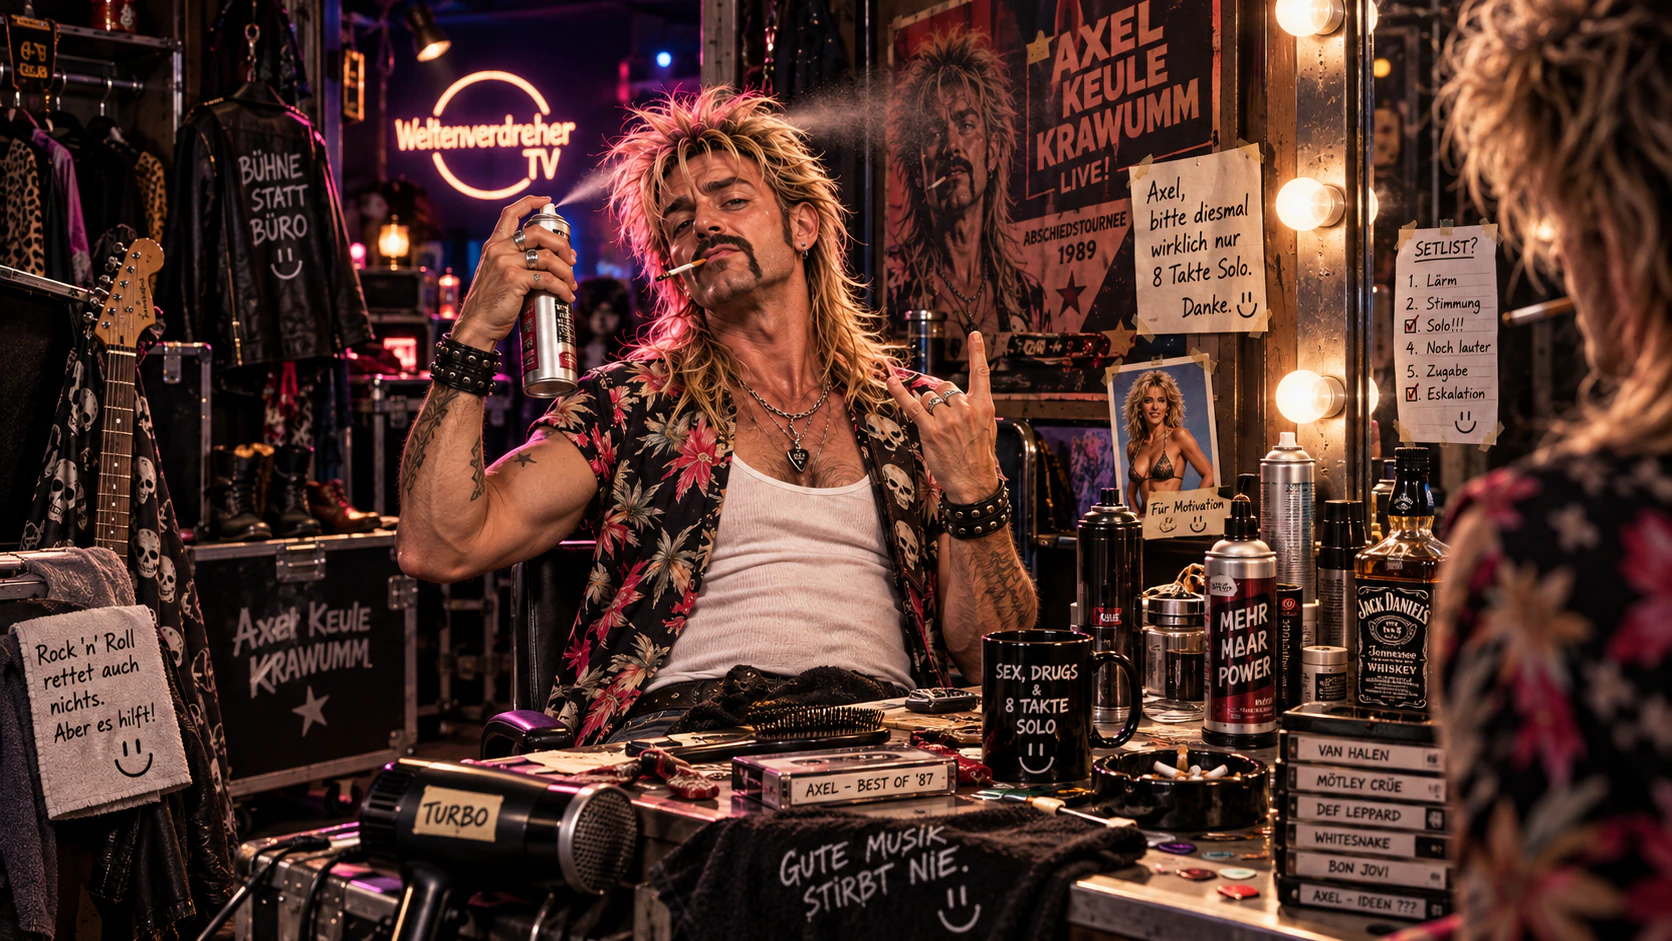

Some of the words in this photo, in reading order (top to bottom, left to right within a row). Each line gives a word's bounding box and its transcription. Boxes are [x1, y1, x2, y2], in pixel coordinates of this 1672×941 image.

[1050, 0, 1164, 85] AXEL
[1062, 43, 1169, 119] KEULE
[394, 113, 576, 151] Weltenverdreher
[1036, 77, 1200, 172] KRAWUMM
[238, 149, 303, 187] BÜHNE
[522, 147, 562, 180] TV
[1060, 156, 1110, 194] LIVE!
[251, 183, 309, 213] STATT
[1147, 176, 1185, 204] Axel,
[1150, 208, 1187, 231] bitte
[1194, 193, 1249, 223] diesmal
[249, 212, 308, 247] BÜRO
[1023, 211, 1127, 247] ABSCHIEDSTOURNEE
[1057, 240, 1097, 264] 1989
[1151, 231, 1207, 258] wirklich
[1215, 233, 1241, 249] nur
[1414, 237, 1478, 257] SETLIST?
[1152, 266, 1162, 287] 8
[1169, 261, 1211, 285] Takte
[1217, 255, 1252, 279] Solo.
[1408, 274, 1418, 288] 1.
[1427, 273, 1457, 287] Lärm
[1182, 294, 1232, 318] Danke.
[1406, 297, 1418, 311] 2.
[1427, 296, 1481, 314] Stimmung
[1427, 317, 1464, 332] Solo!!!
[1406, 341, 1418, 355] 4.
[1427, 341, 1454, 354] Noch
[1459, 339, 1491, 354] lauter
[1407, 364, 1419, 378] 5.
[1427, 363, 1468, 382] Zugabe
[1427, 385, 1485, 400] Eskalation
[1173, 498, 1224, 513] Motivation
[1220, 602, 1269, 633] MEHR
[1358, 596, 1385, 620] JACK
[35, 639, 78, 666] Rock
[81, 634, 98, 656] 'n'
[104, 628, 135, 653] Roll
[43, 663, 94, 690] rettet
[102, 654, 140, 678] auch
[995, 663, 1026, 683] SEX,
[1030, 663, 1079, 681] DRUGS
[1218, 655, 1272, 688] POWER
[1367, 662, 1417, 675] WHISKEY
[50, 690, 105, 716] nichts.
[1032, 684, 1042, 696] &
[1005, 697, 1014, 713] 8
[1019, 697, 1069, 714] TAKTE
[54, 721, 91, 744] Aber
[97, 718, 113, 733] es
[118, 702, 156, 728] hilft!
[1016, 718, 1057, 735] SOLO
[1318, 744, 1343, 758] VAN
[1348, 746, 1390, 762] HALEN
[805, 782, 839, 798] AXEL
[857, 777, 889, 793] BEST
[893, 775, 911, 789] OF
[915, 772, 934, 787] '87
[1316, 772, 1366, 790] MÖTLEY
[423, 801, 489, 828] TURBO
[1316, 803, 1341, 817] DEF
[1346, 806, 1402, 822] LEPPARD
[1315, 831, 1391, 850] WHITESNAKE
[779, 841, 850, 887] GUTE
[865, 824, 948, 864] MUSIK
[1328, 860, 1355, 874] BON
[1360, 863, 1389, 878] JOVI
[803, 862, 895, 923] STIRBT
[1312, 890, 1342, 905] AXEL
[1358, 895, 1392, 910] IDEEN
[1397, 900, 1417, 914] ???
